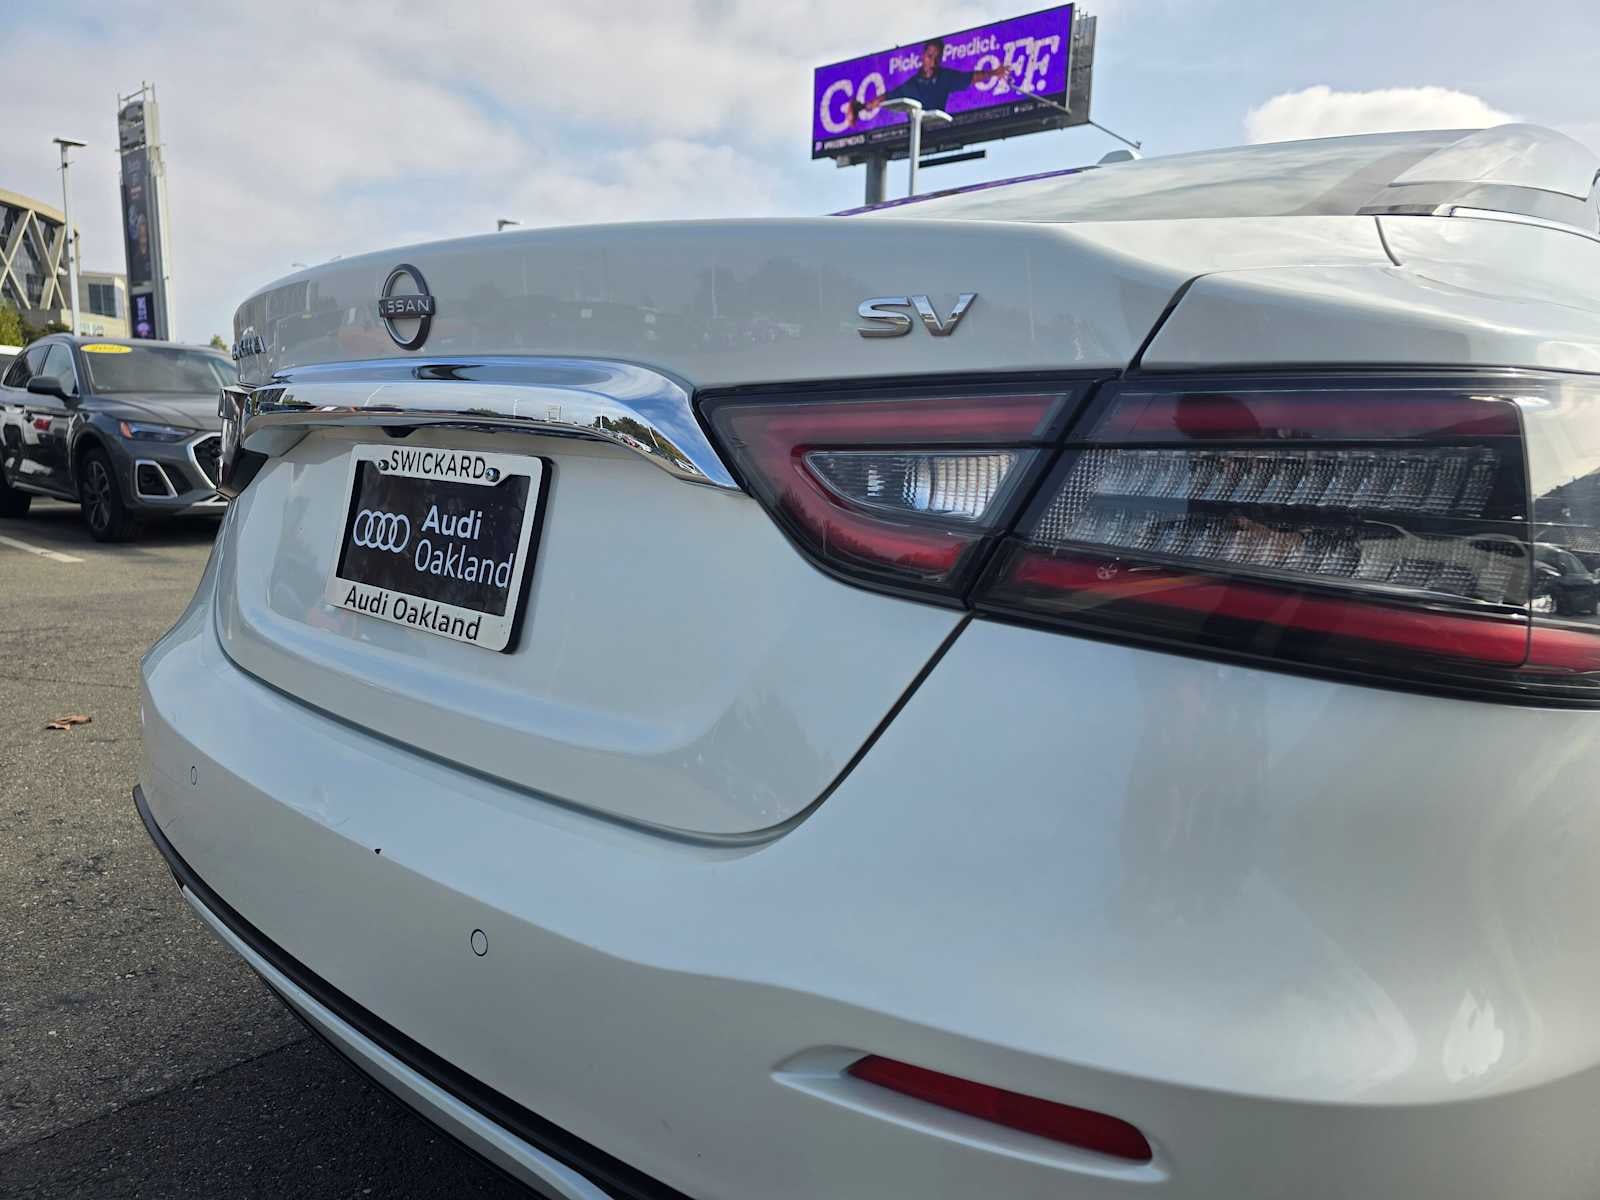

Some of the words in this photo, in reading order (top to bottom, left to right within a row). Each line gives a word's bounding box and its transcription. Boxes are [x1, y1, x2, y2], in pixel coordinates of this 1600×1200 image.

[889, 52, 923, 75] Pick.
[942, 34, 1000, 62] Predict.
[820, 71, 887, 134] GO
[380, 299, 431, 314] SSAN
[857, 292, 978, 339] SV
[390, 449, 486, 479] SWICKARD
[421, 504, 483, 541] Audi
[414, 538, 514, 589] Oakland
[344, 585, 389, 617] Audi
[393, 597, 482, 641] Oakland
